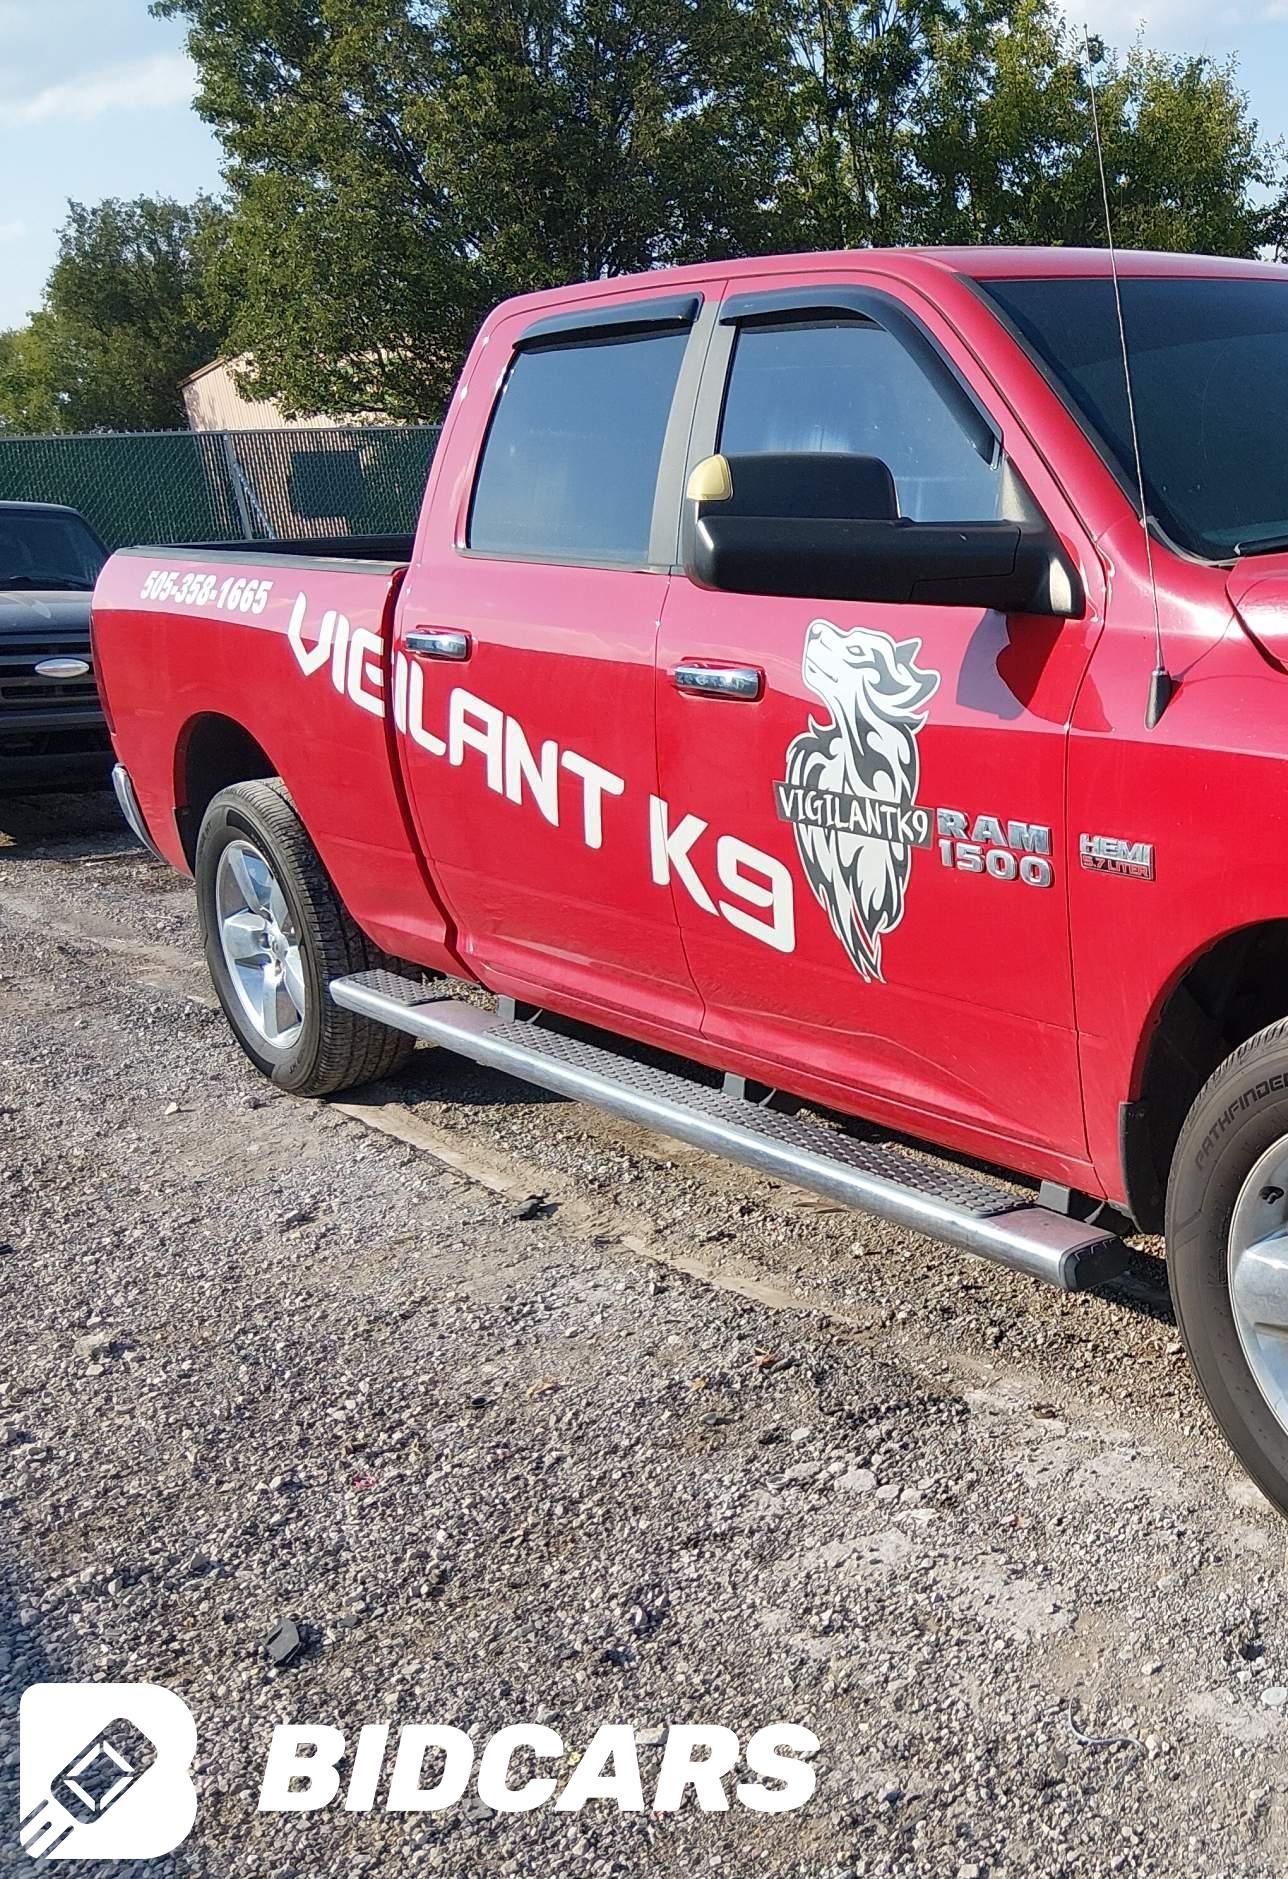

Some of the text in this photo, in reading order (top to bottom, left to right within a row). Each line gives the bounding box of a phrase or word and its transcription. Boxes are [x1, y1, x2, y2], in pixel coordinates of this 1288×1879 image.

[140, 570, 274, 615] 505-358-1665
[288, 591, 796, 954] VIGILANT K9
[936, 807, 1054, 855] RAM
[1080, 833, 1153, 866] HEMI
[937, 839, 1054, 889] 1500
[1082, 855, 1149, 878] 5.7 LITER
